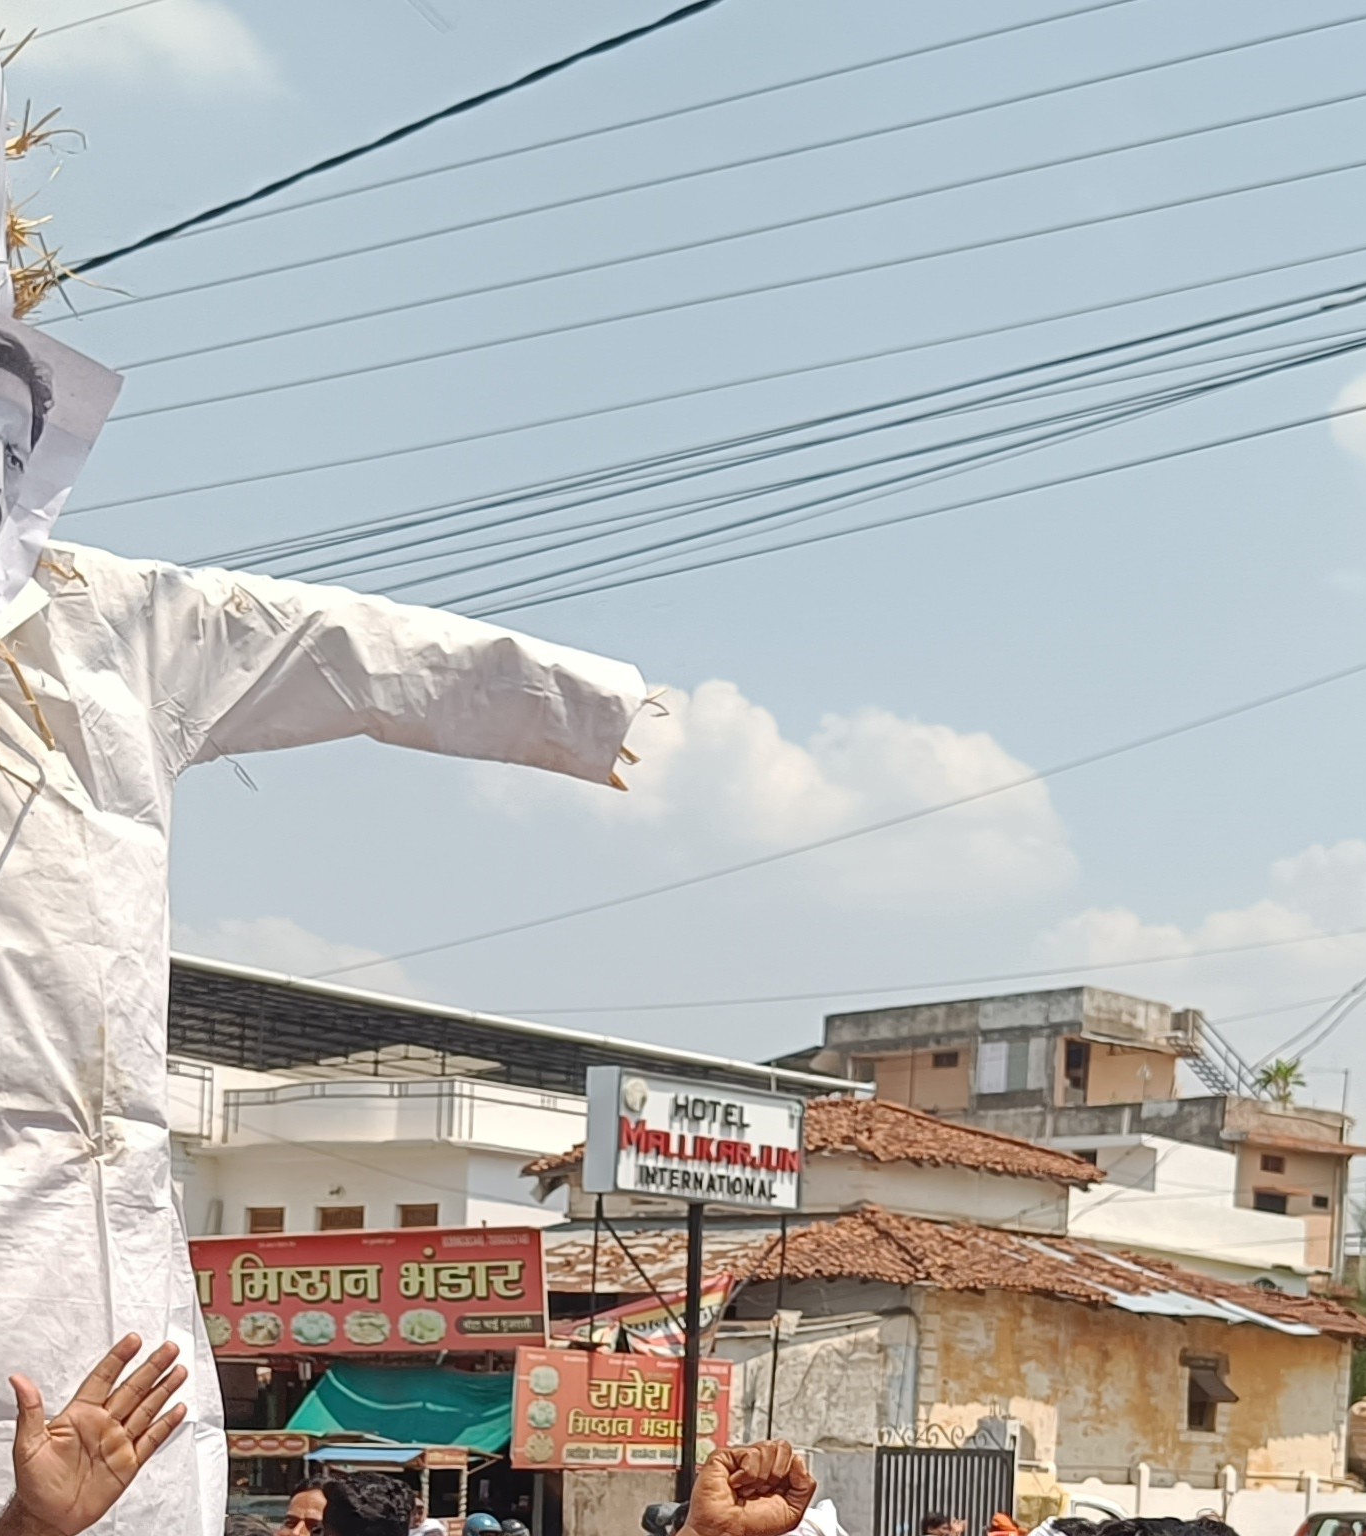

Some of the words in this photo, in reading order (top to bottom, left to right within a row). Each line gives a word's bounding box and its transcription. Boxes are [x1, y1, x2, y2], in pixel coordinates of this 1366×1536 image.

[672, 1094, 751, 1128] HOTEL
[619, 1115, 803, 1173] MALLIKARJUN
[638, 1165, 778, 1200] INTERNATIONAL
[228, 1252, 384, 1305] मिष्ठान
[398, 1246, 527, 1301] भंडार
[589, 1369, 673, 1411] राजेश
[567, 1408, 635, 1437] मिष्ठान
